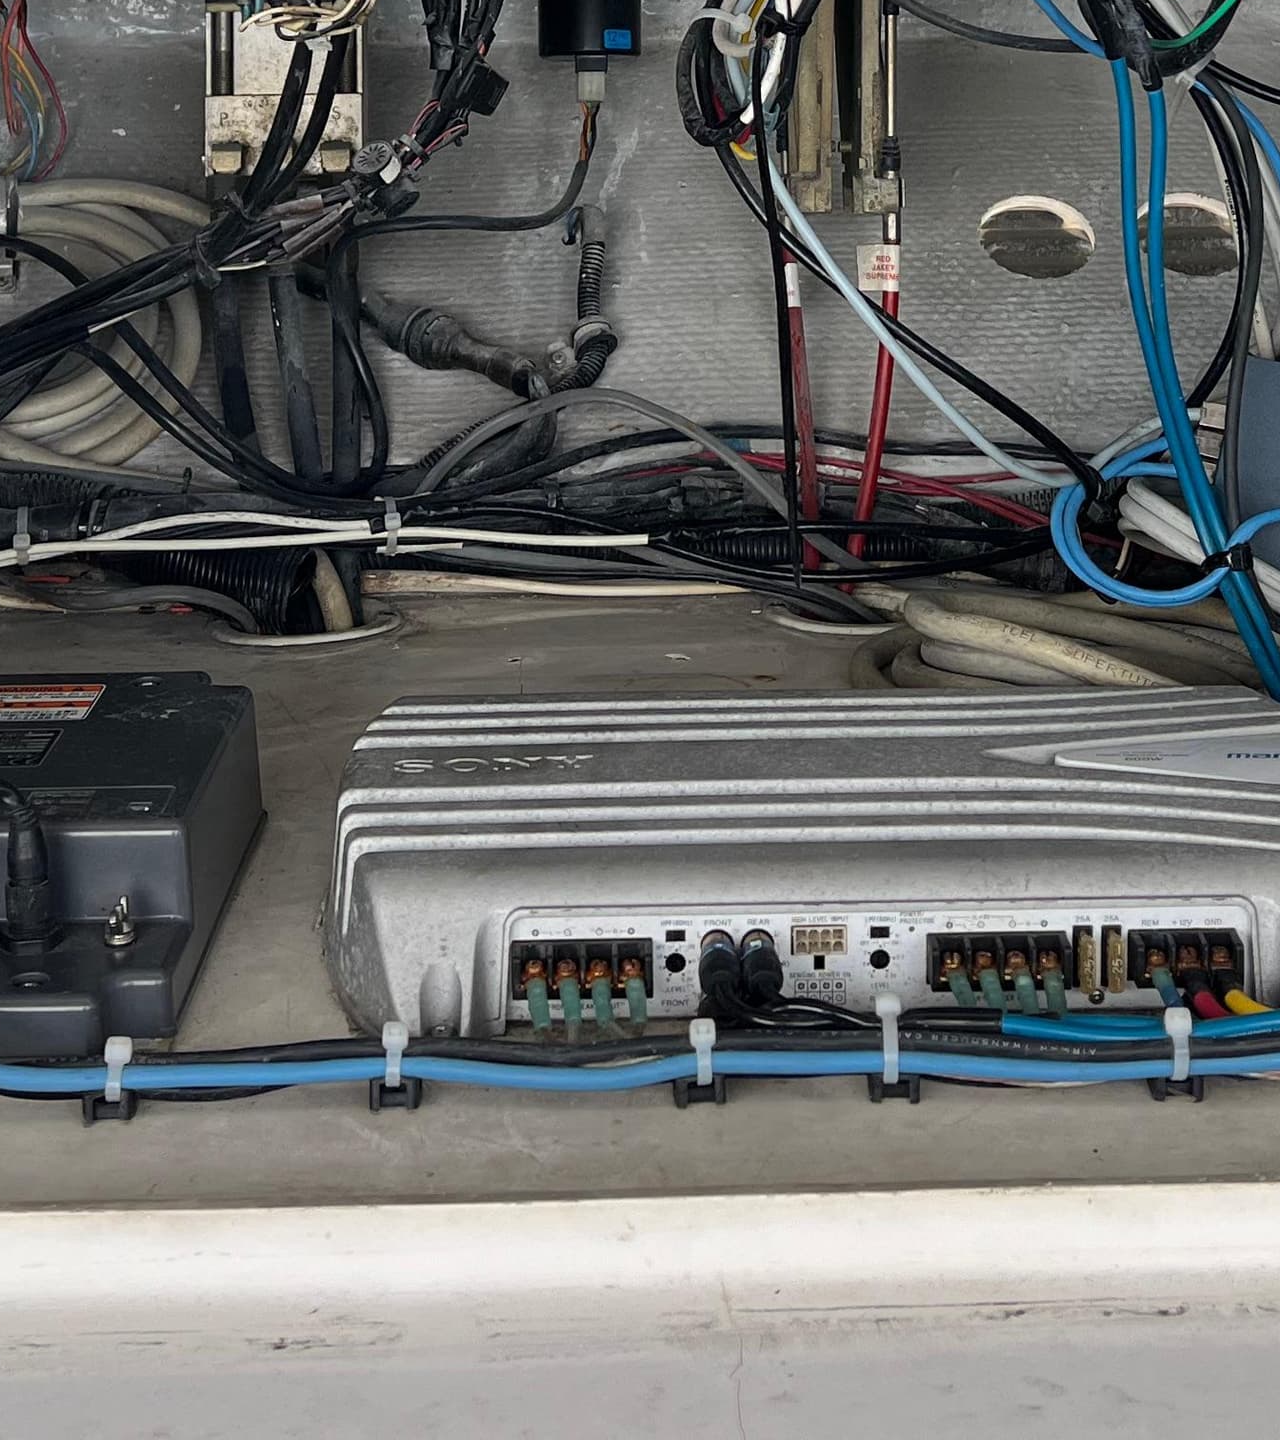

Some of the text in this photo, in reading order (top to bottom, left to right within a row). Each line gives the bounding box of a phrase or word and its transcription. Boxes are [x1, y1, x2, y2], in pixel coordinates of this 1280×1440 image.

[875, 255, 891, 263] RED
[394, 754, 594, 773] SONY
[703, 919, 733, 927] FRONT
[746, 918, 771, 926] REAR
[1075, 915, 1091, 923] 25A
[1141, 919, 1160, 927] REM
[1204, 918, 1223, 926] GND
[1111, 958, 1123, 974] 25
[789, 971, 816, 979] SENSING
[660, 998, 690, 1008] FRONT
